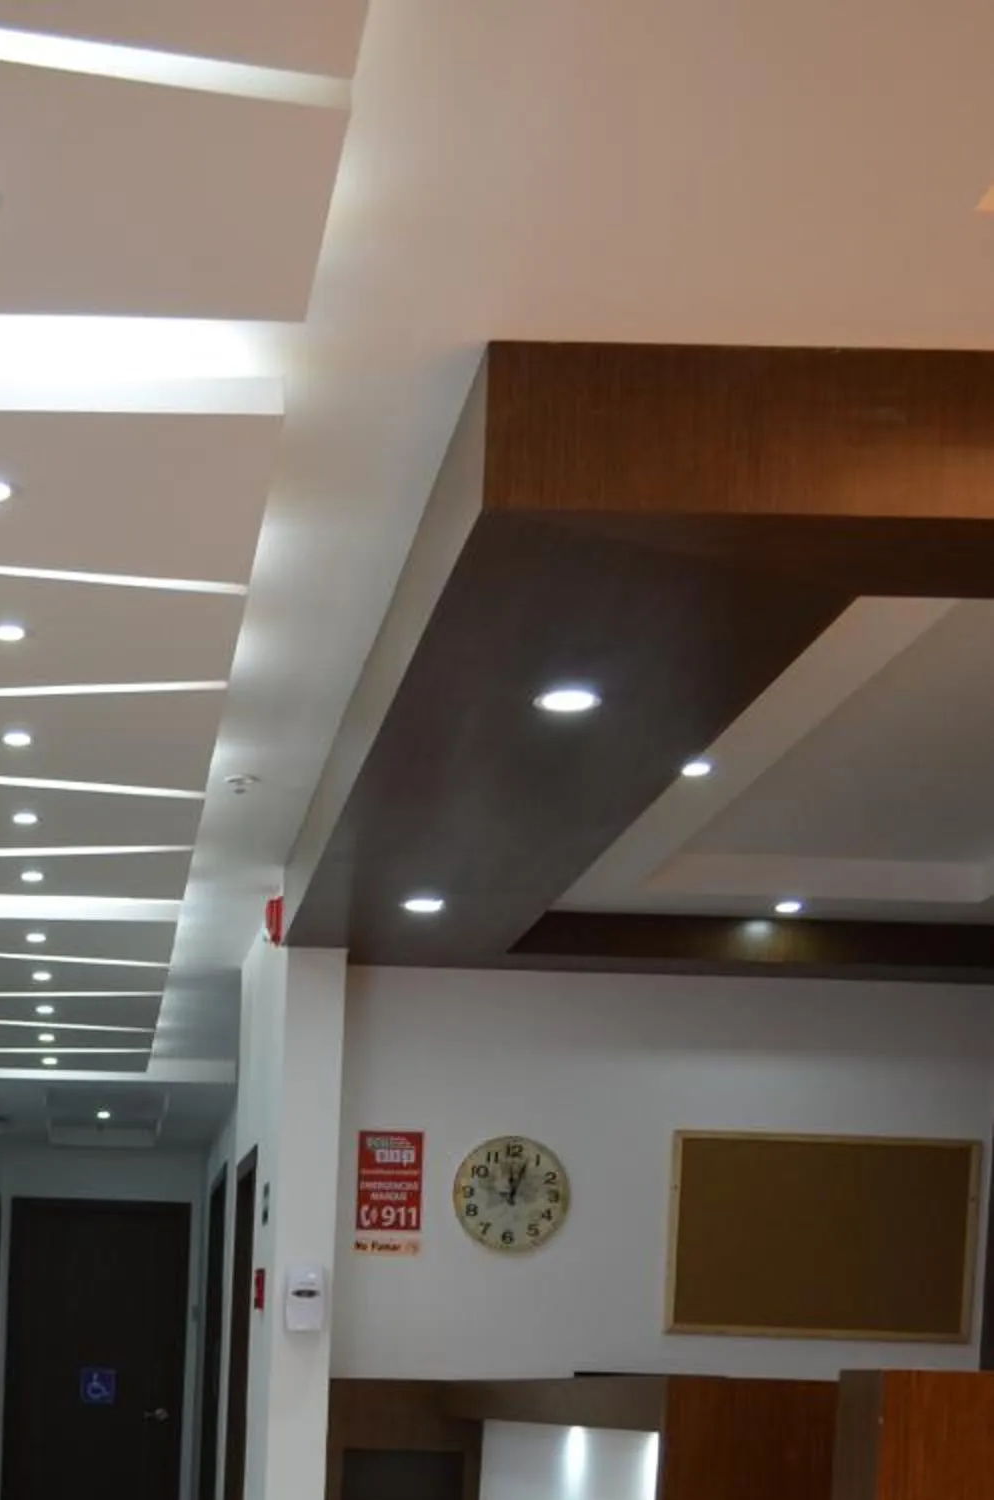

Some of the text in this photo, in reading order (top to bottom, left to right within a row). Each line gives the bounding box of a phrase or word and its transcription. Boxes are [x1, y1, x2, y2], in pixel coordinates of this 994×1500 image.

[487, 1151, 499, 1164] 11
[506, 1144, 524, 1157] 12
[535, 1154, 541, 1167] 1
[471, 1165, 489, 1178] 10
[543, 1172, 557, 1185] 2
[462, 1185, 474, 1199] 9
[548, 1189, 559, 1203] 3
[381, 1205, 418, 1227] 911
[466, 1203, 478, 1217] 8
[542, 1208, 553, 1221] 4
[480, 1221, 492, 1236] 7
[526, 1223, 539, 1237] 5
[501, 1230, 514, 1245] 6
